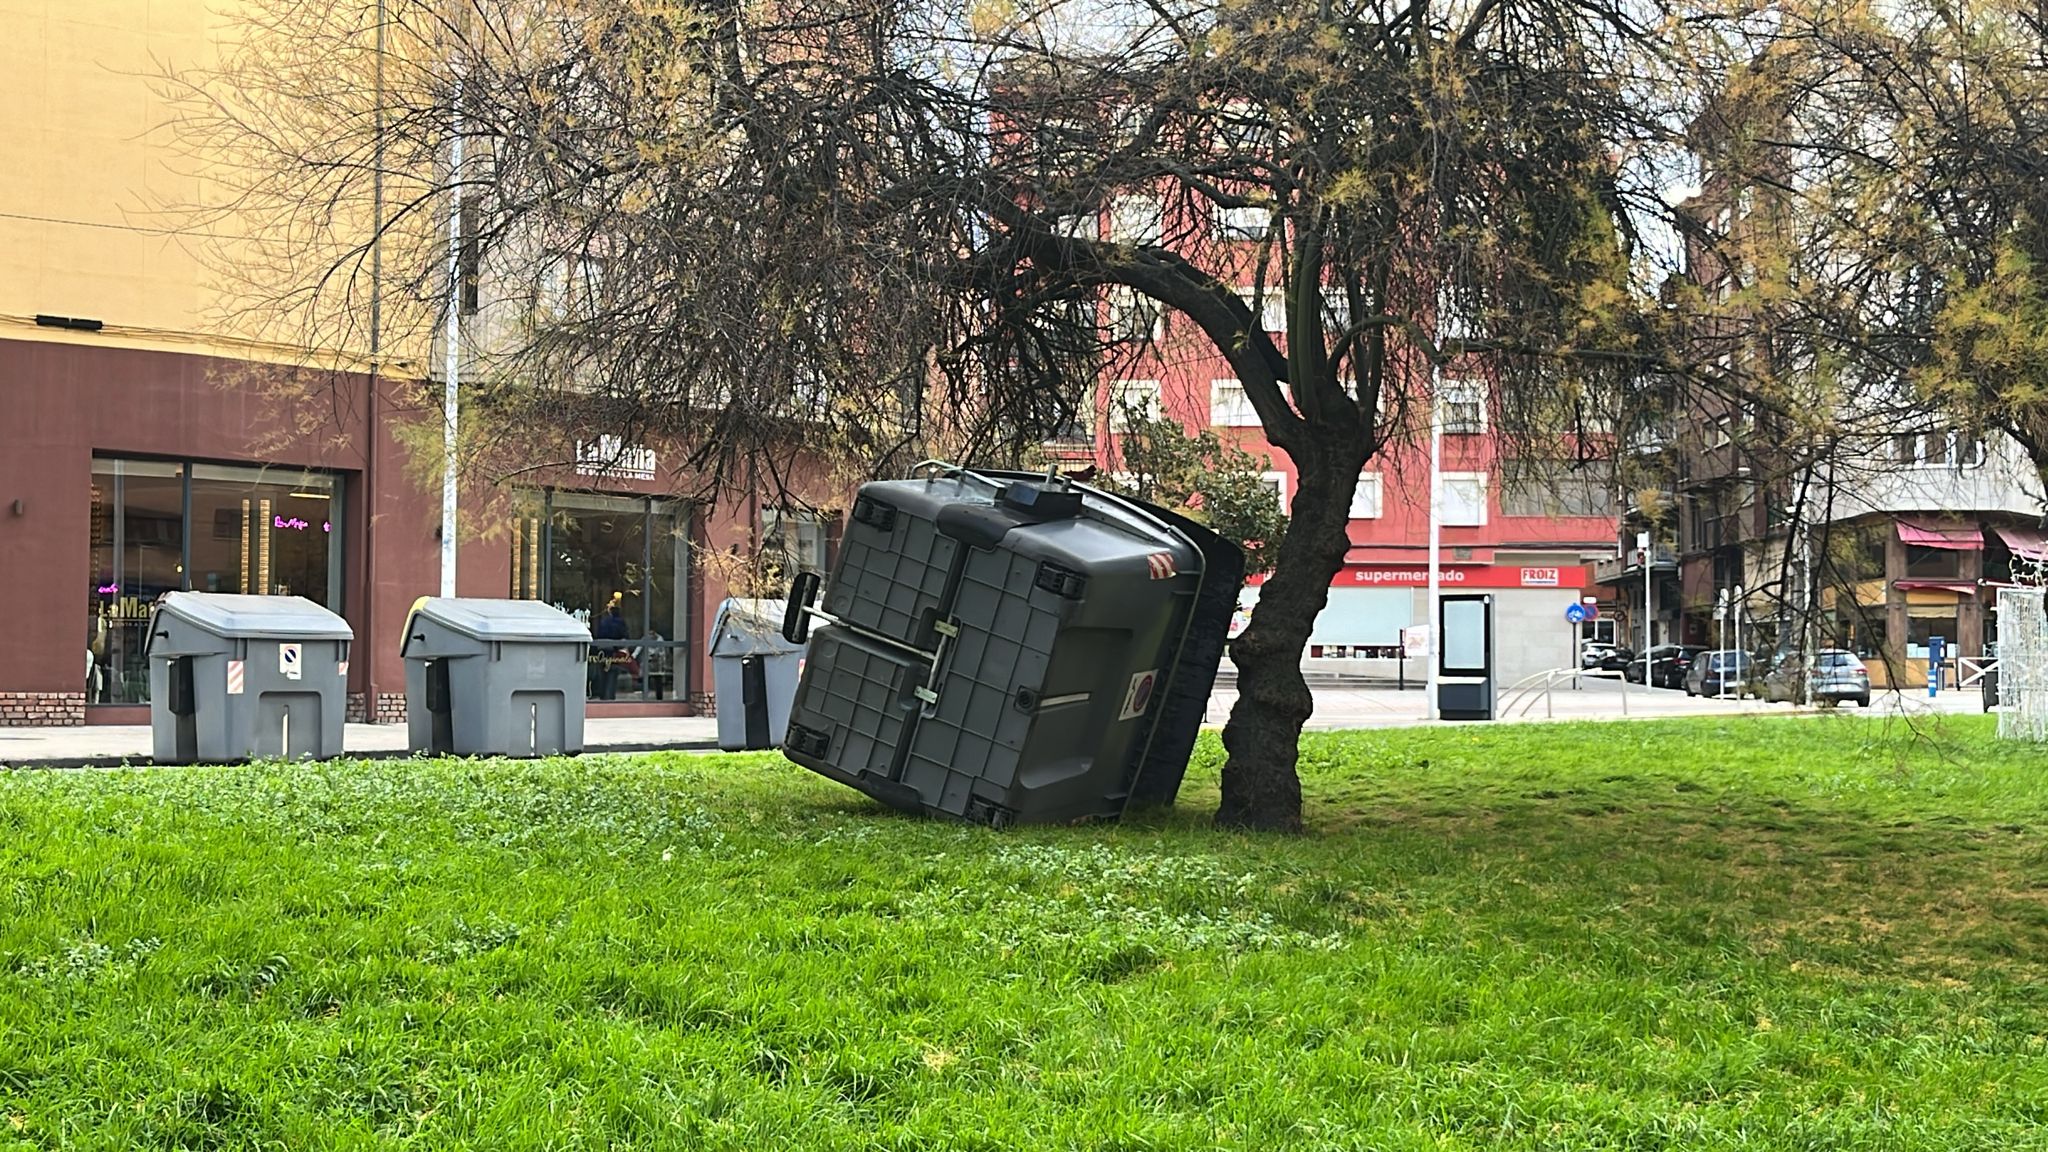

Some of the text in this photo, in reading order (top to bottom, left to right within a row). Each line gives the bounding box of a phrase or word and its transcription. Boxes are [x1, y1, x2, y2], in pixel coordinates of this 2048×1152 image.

[634, 472, 656, 481] MESA
[1355, 569, 1465, 584] supermerado
[1522, 569, 1556, 580] FROIZ
